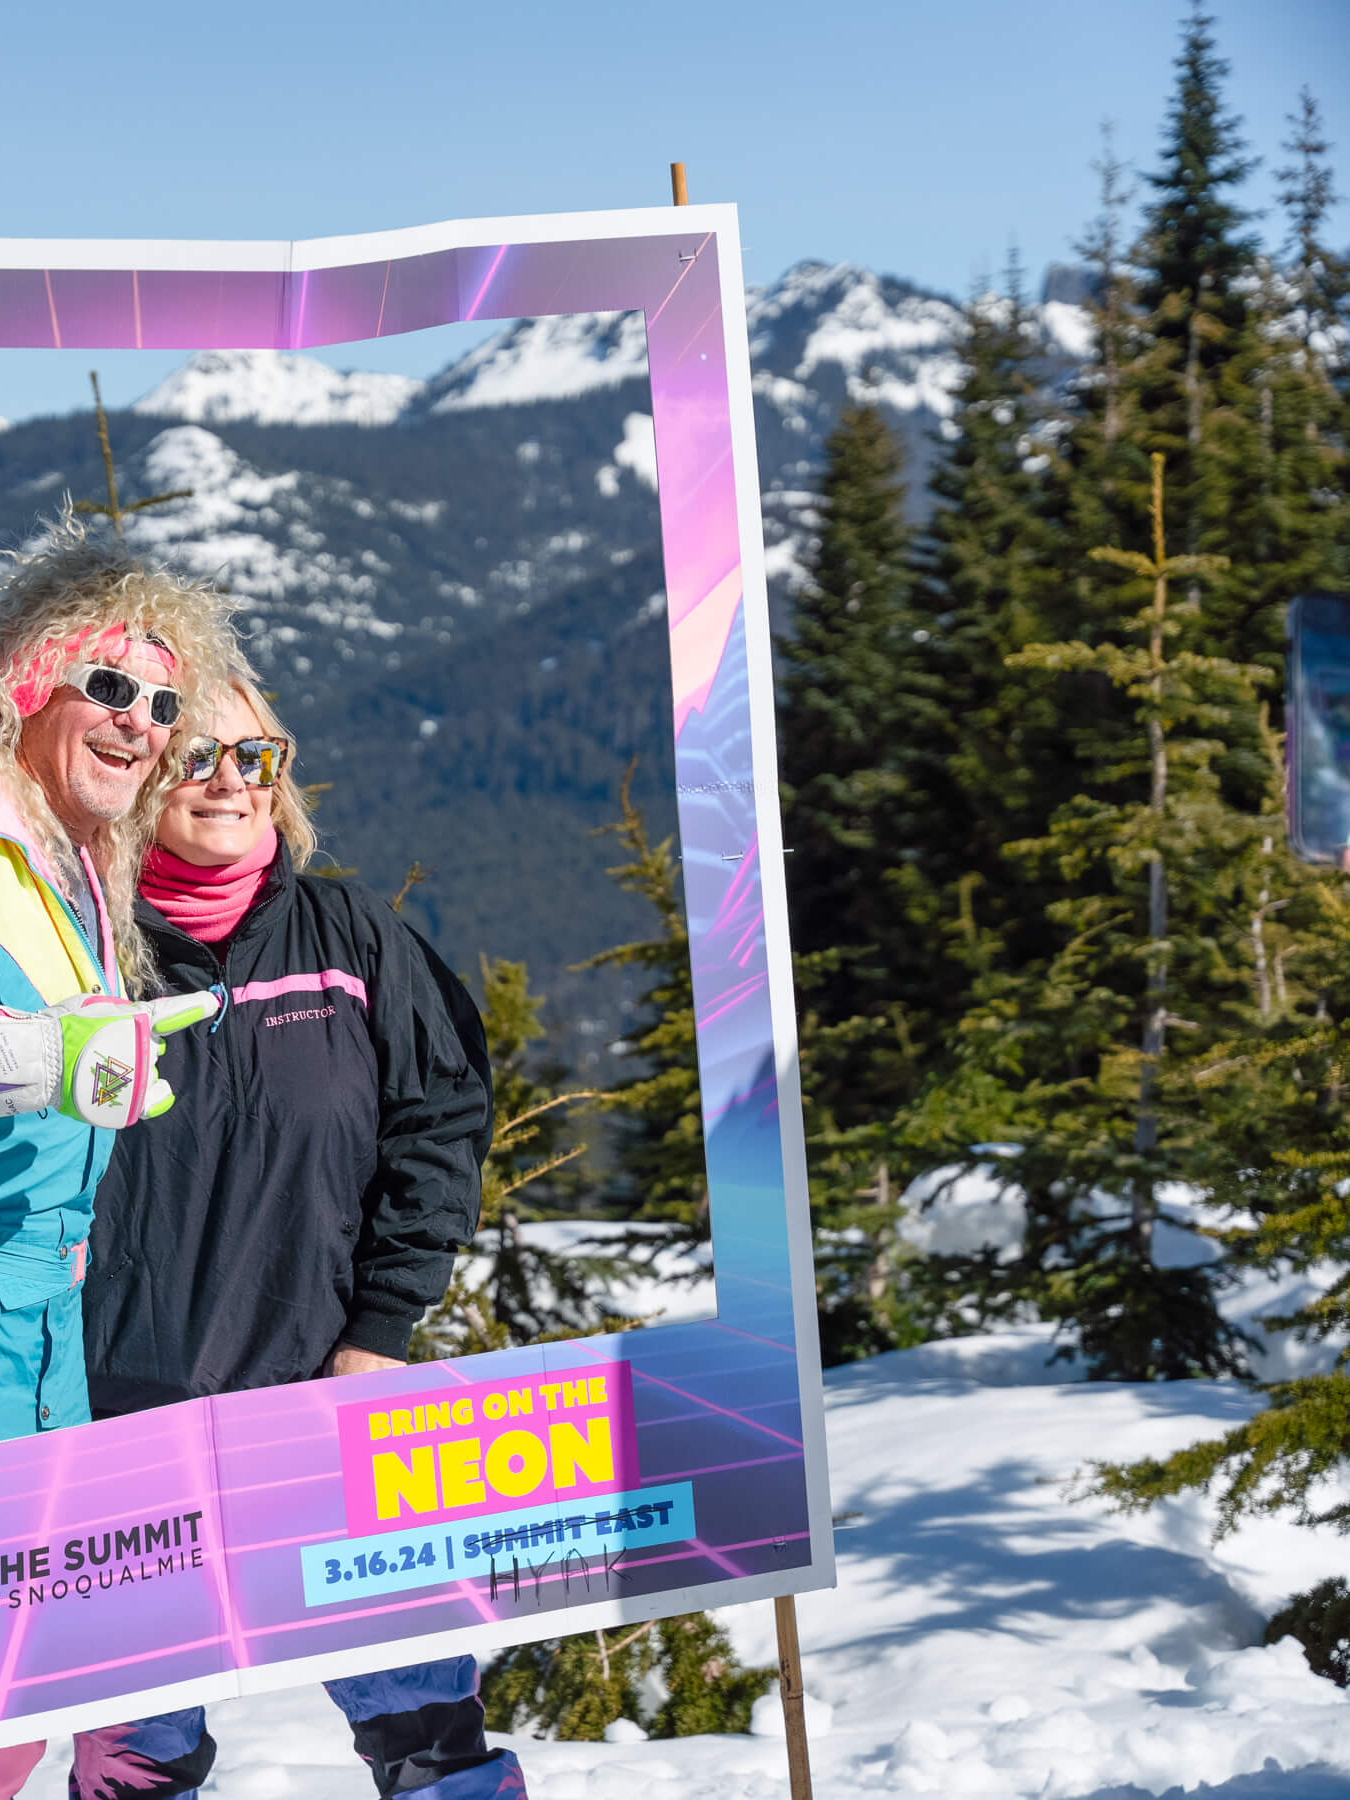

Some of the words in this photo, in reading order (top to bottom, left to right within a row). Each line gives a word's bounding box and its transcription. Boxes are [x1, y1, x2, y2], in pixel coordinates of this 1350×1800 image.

[265, 1005, 336, 1027] INSTRUCTOR
[368, 1397, 474, 1441] BRING
[482, 1387, 534, 1420] ON
[539, 1375, 608, 1411] THE
[371, 1415, 615, 1521] NEON
[63, 1510, 203, 1571] SUMMIT
[324, 1542, 436, 1584] 3.16.24
[463, 1514, 586, 1559] SUMMIT
[595, 1500, 675, 1537] EAST
[8, 1547, 204, 1609] SNOQUALMIE
[489, 1543, 633, 1606] HYAK
